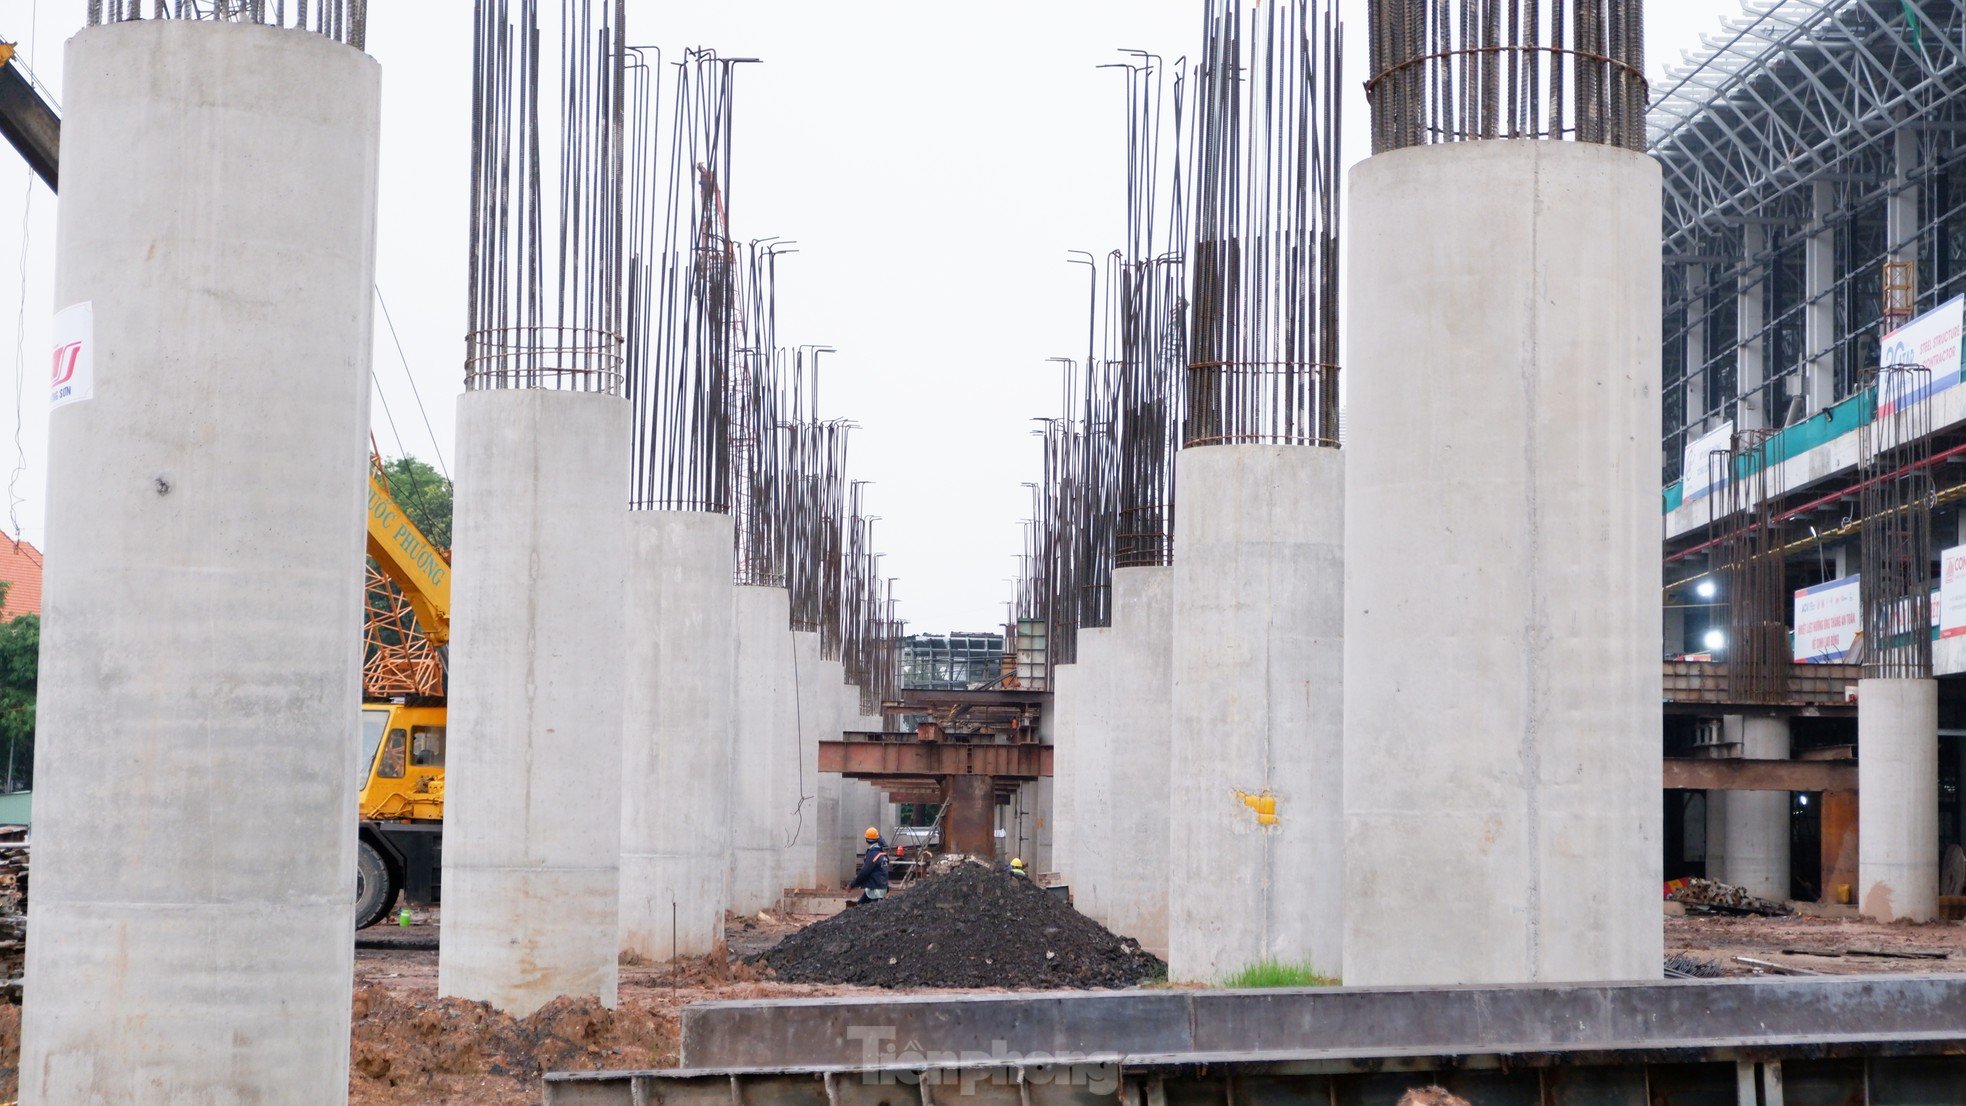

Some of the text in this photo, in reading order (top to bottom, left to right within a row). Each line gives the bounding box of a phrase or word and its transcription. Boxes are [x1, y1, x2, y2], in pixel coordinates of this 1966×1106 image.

[1919, 325, 1960, 355] STEEL STRUCTURE
[393, 523, 445, 586] PHƯƠNG
